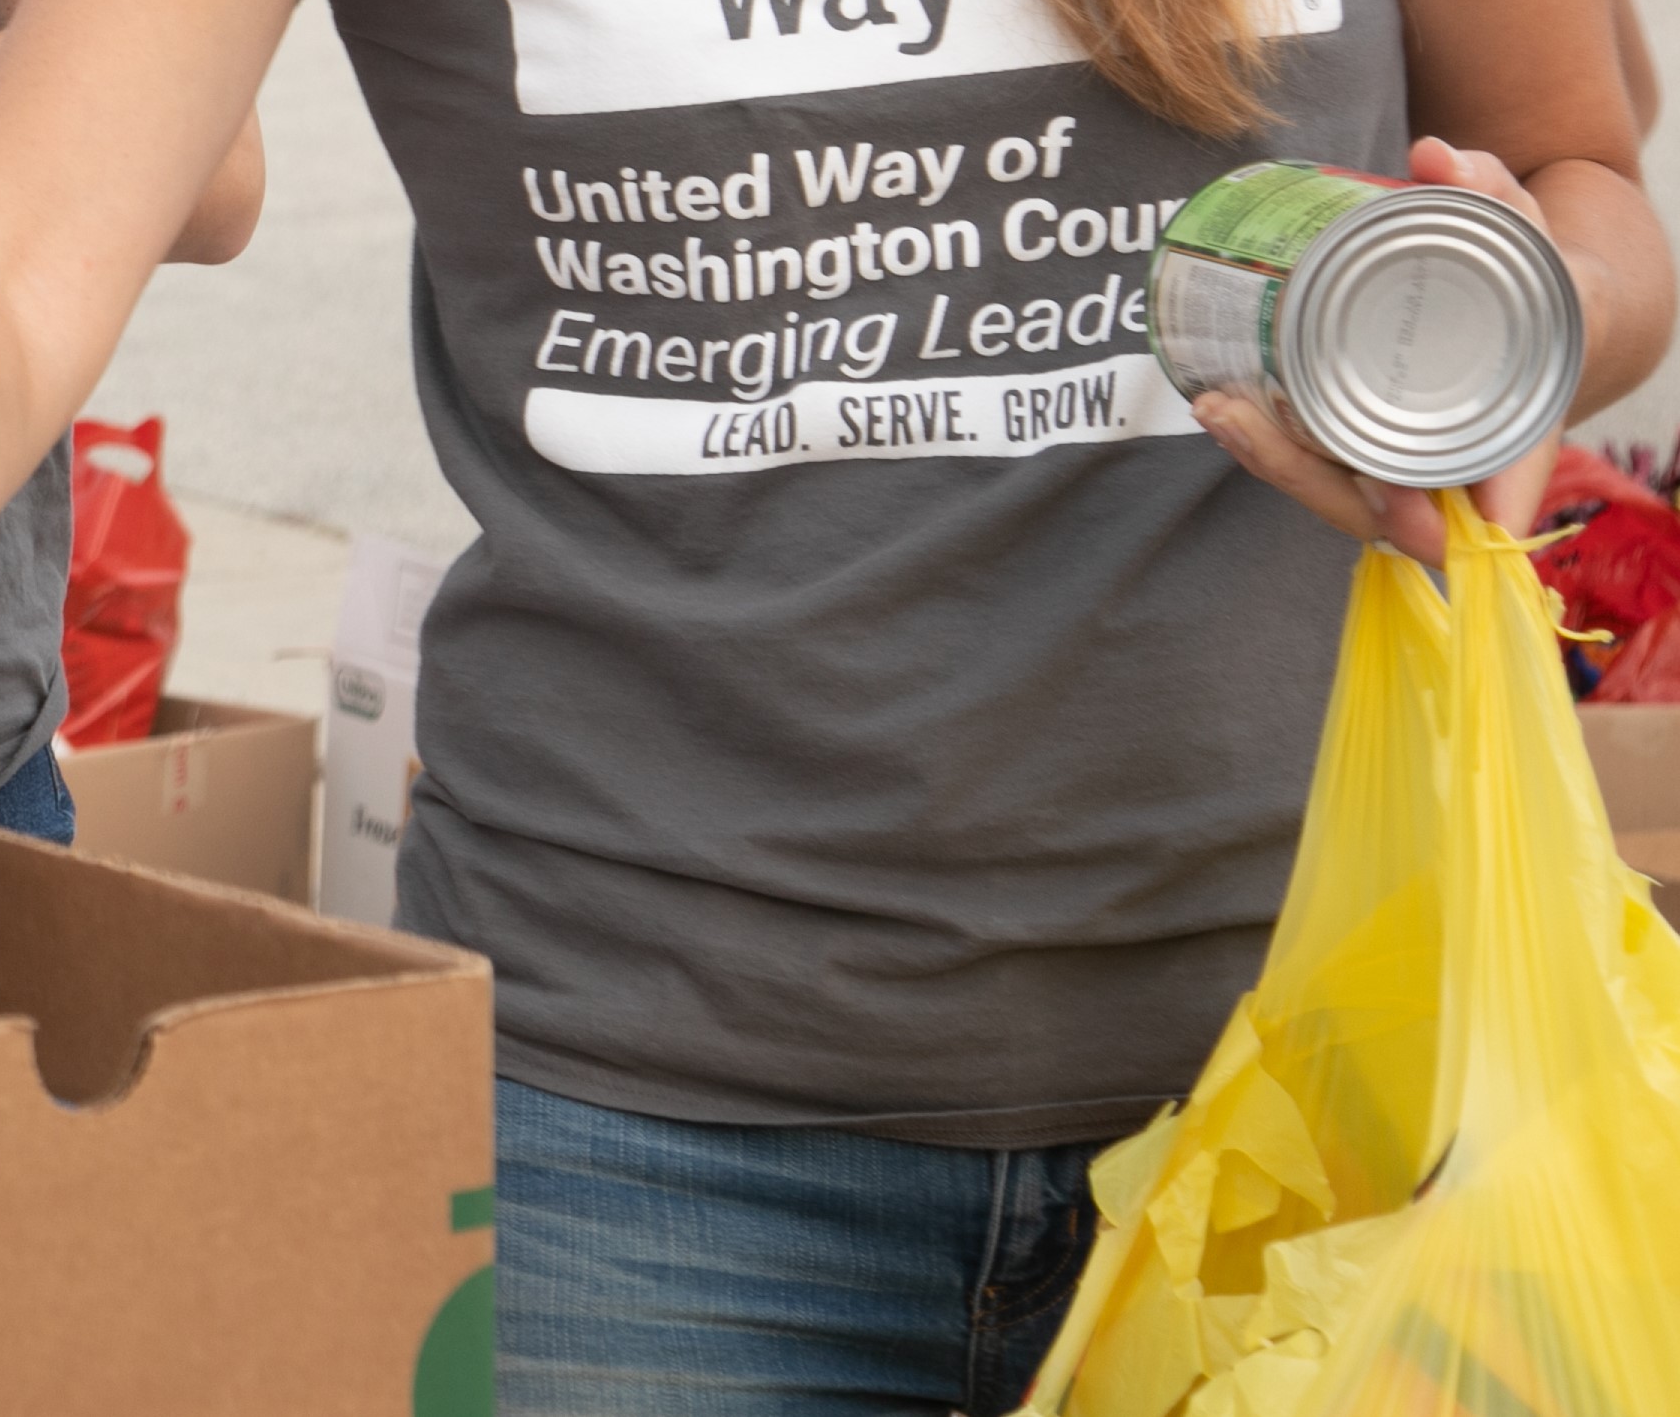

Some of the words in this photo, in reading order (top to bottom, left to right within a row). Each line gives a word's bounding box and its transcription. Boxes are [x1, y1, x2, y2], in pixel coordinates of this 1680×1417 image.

[524, 153, 771, 225] United
[795, 142, 965, 209] Way
[986, 116, 1076, 184] of
[537, 220, 982, 305] Washington
[1003, 194, 1186, 263] Coun
[537, 306, 897, 401] Emerging
[918, 273, 1148, 362] Leade
[701, 401, 811, 460] LEAD.
[838, 385, 978, 448] SERVE.
[1003, 372, 1127, 443] GROW.
